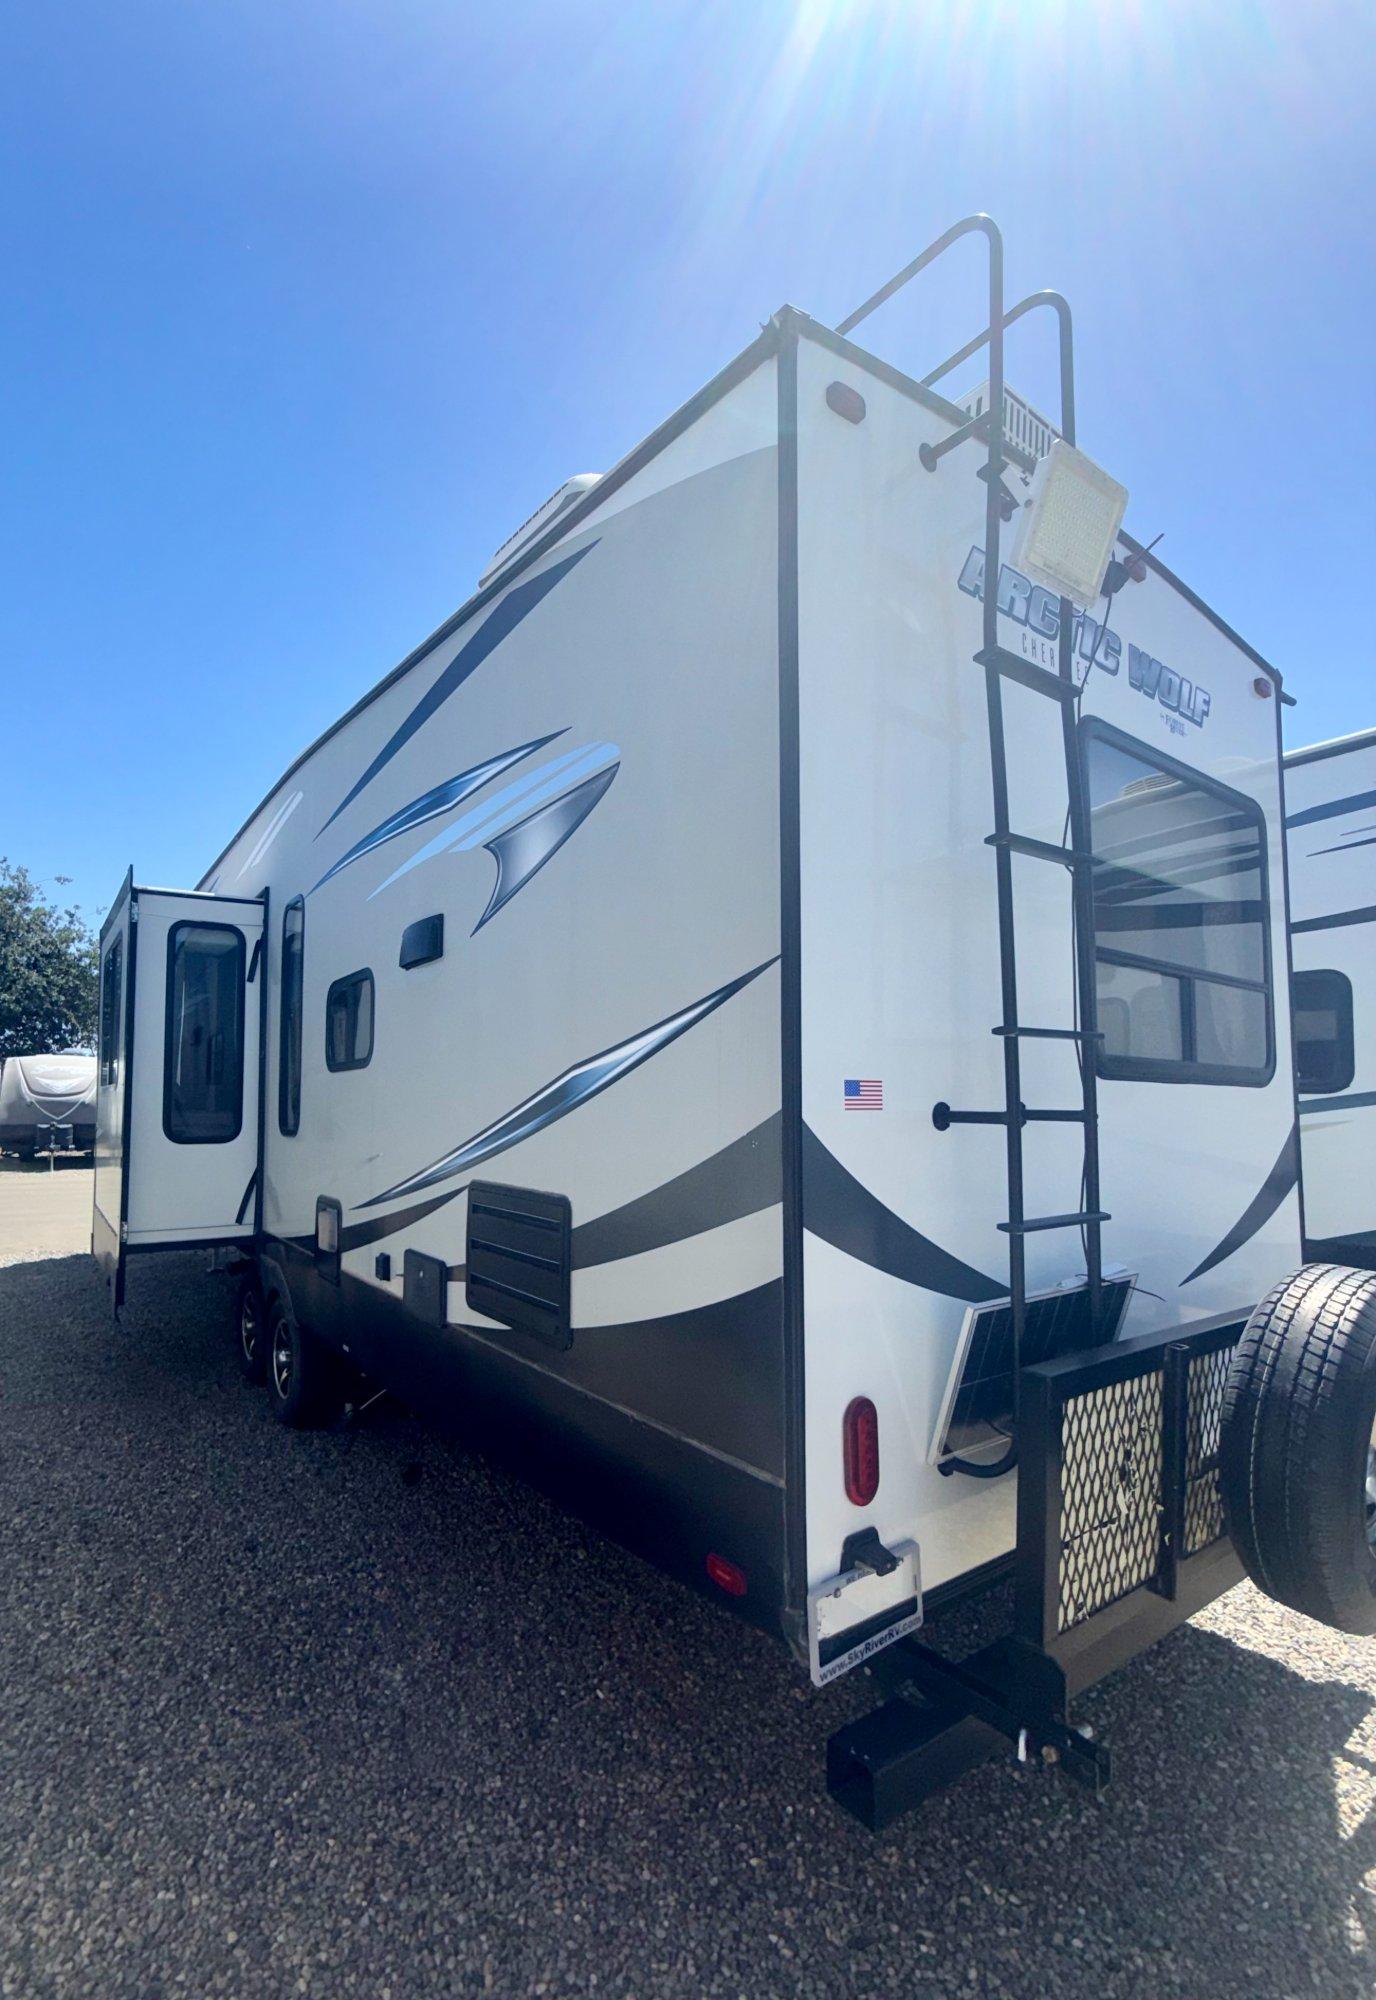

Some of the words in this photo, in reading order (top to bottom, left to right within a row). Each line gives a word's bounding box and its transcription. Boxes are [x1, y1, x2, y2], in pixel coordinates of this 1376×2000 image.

[1022, 633, 1090, 686] CHERE
[1128, 643, 1210, 728] WOLF
[819, 1616, 921, 1682] www.SkyRiverRV.com
